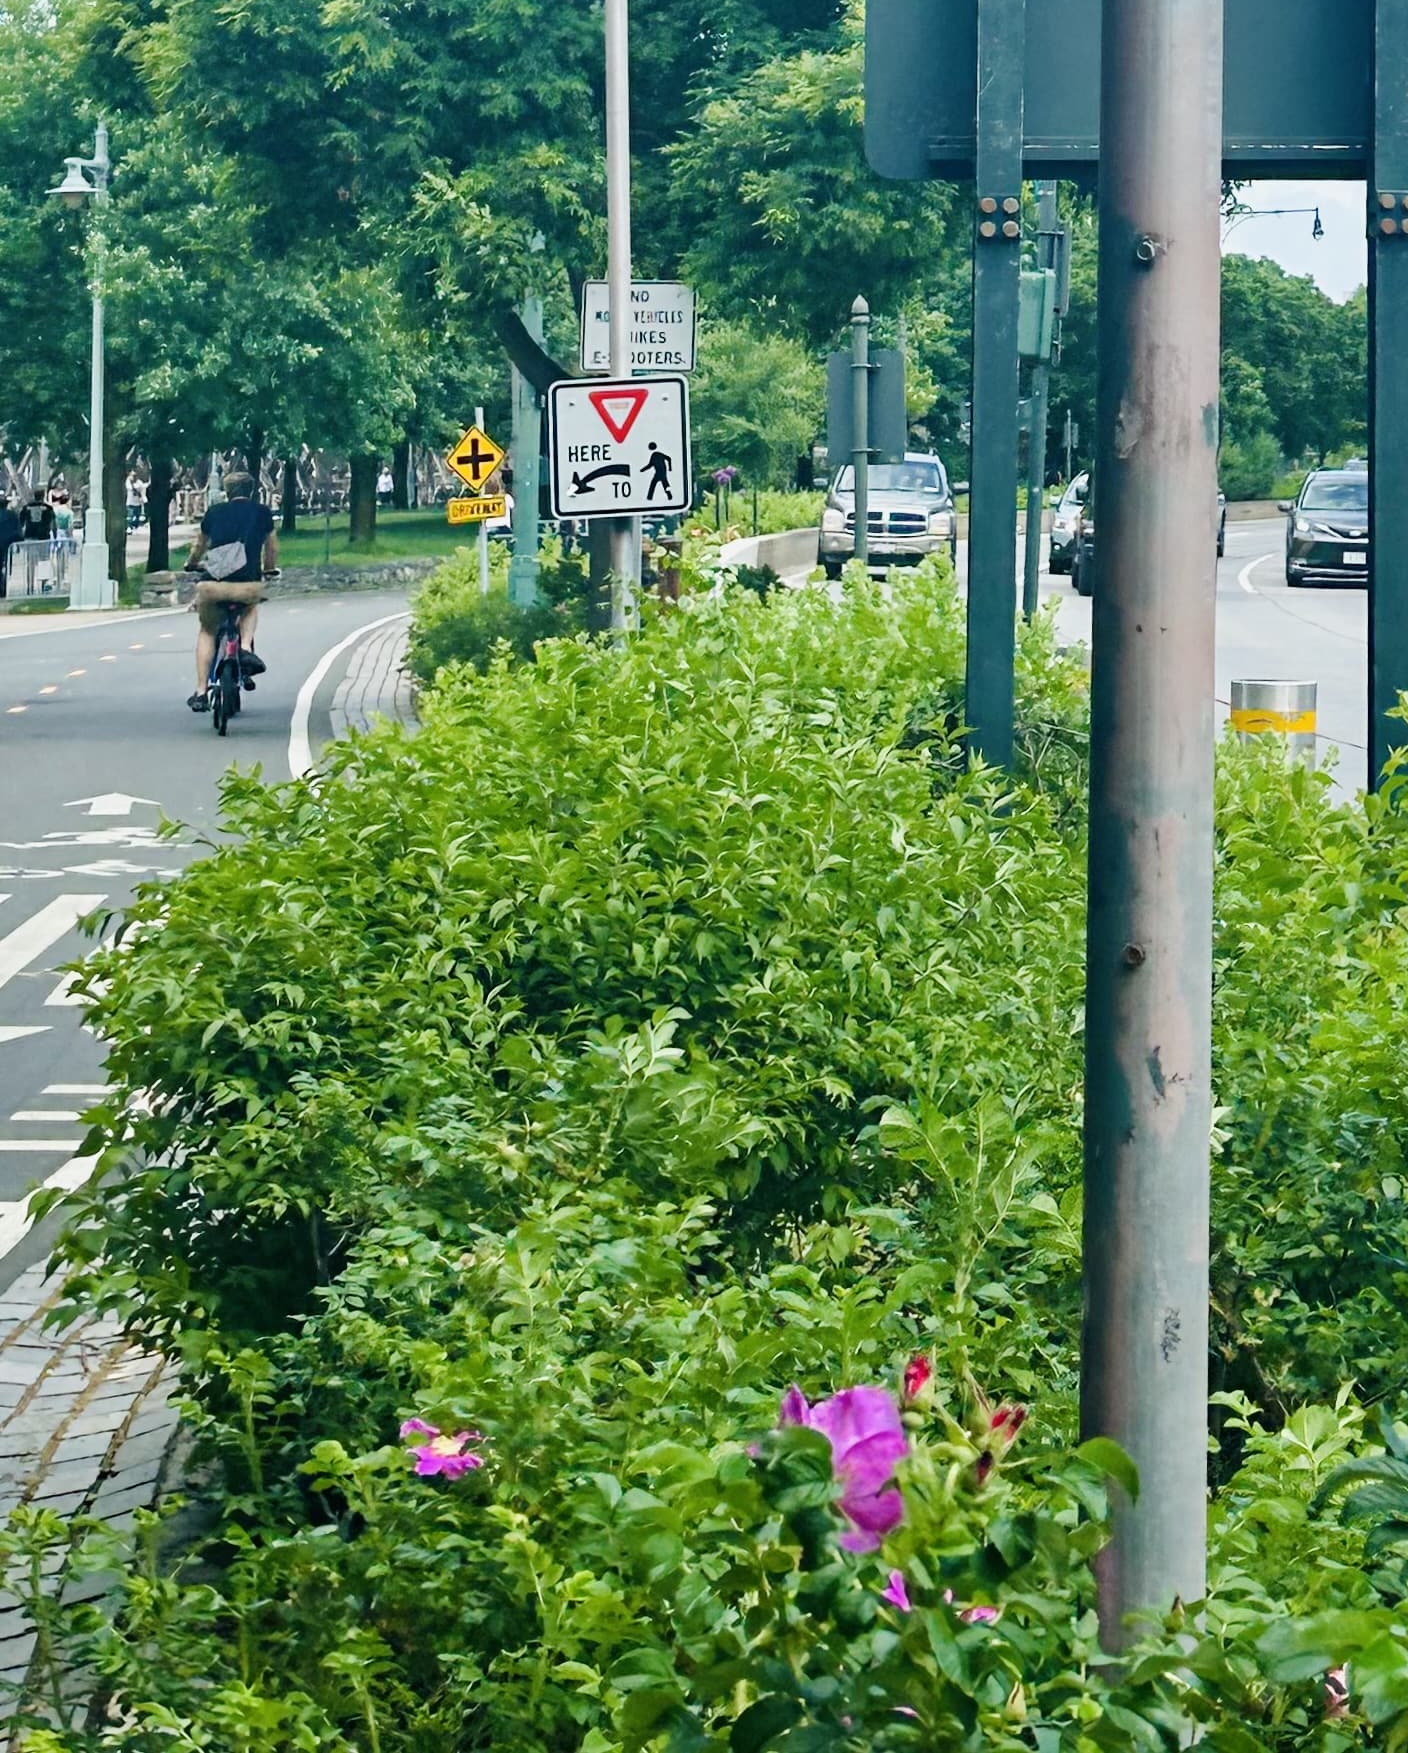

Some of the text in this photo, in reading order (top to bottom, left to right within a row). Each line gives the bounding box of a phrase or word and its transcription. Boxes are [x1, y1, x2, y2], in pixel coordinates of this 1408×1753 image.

[630, 290, 650, 303] NO
[630, 330, 667, 345] IKES
[568, 444, 612, 462] HERE
[612, 482, 632, 498] TO
